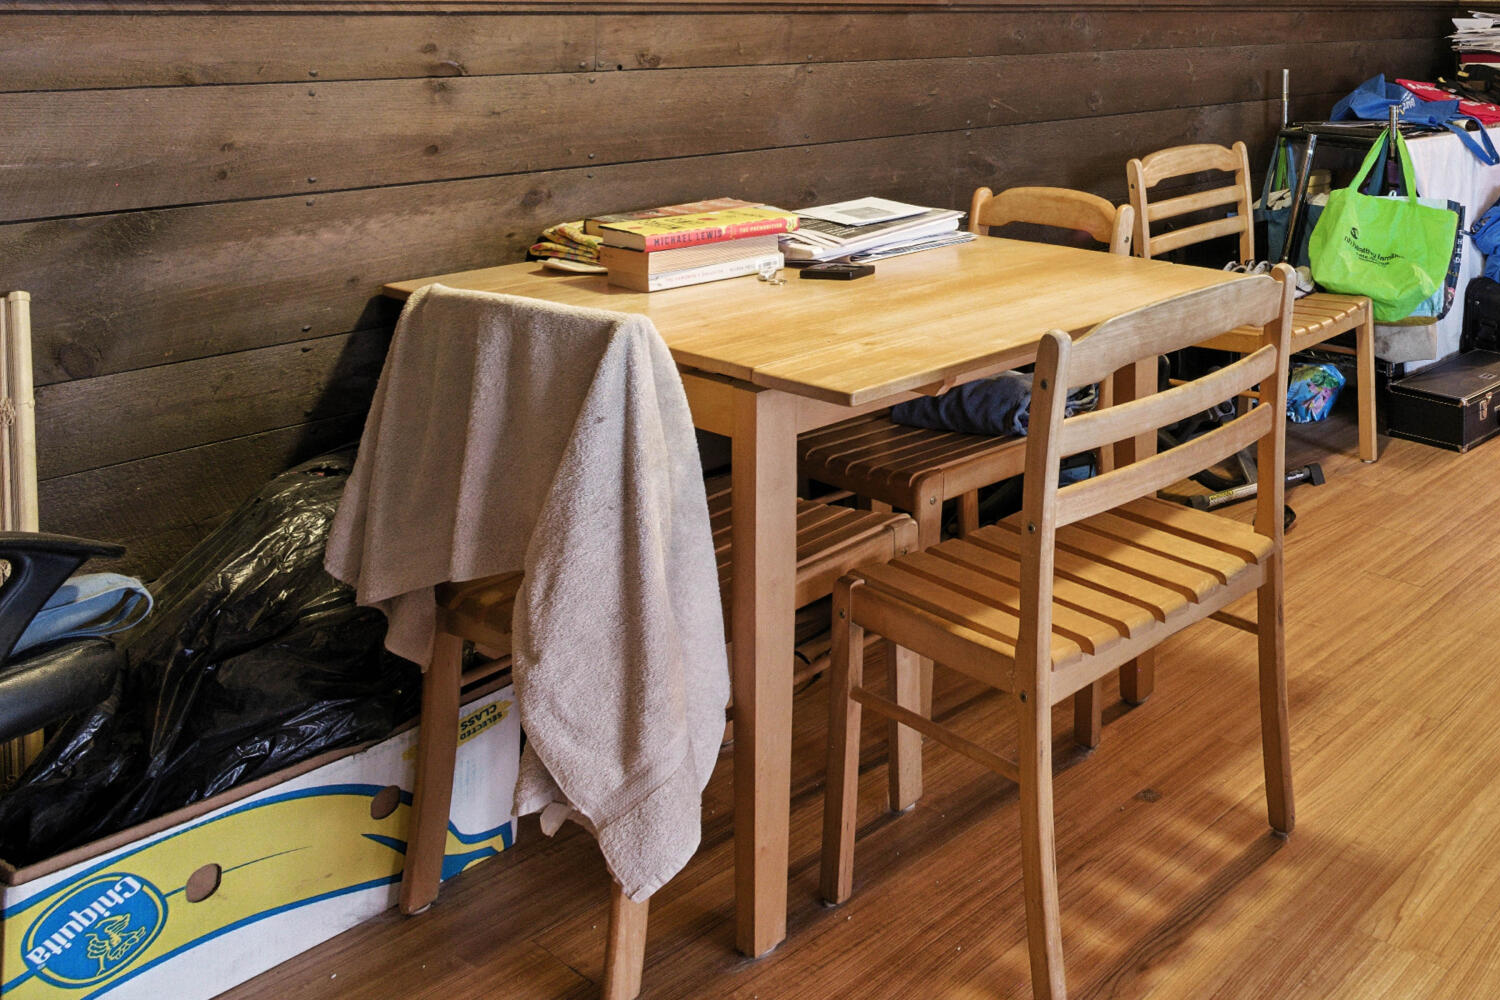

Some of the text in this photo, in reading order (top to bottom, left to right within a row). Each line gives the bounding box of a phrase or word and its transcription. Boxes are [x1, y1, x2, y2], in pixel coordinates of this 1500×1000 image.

[654, 231, 693, 246] MICHAEL
[696, 228, 722, 241] LEWIS
[460, 711, 503, 740] SELECTED
[461, 704, 497, 731] CLASS
[26, 876, 142, 965] Chiquita
